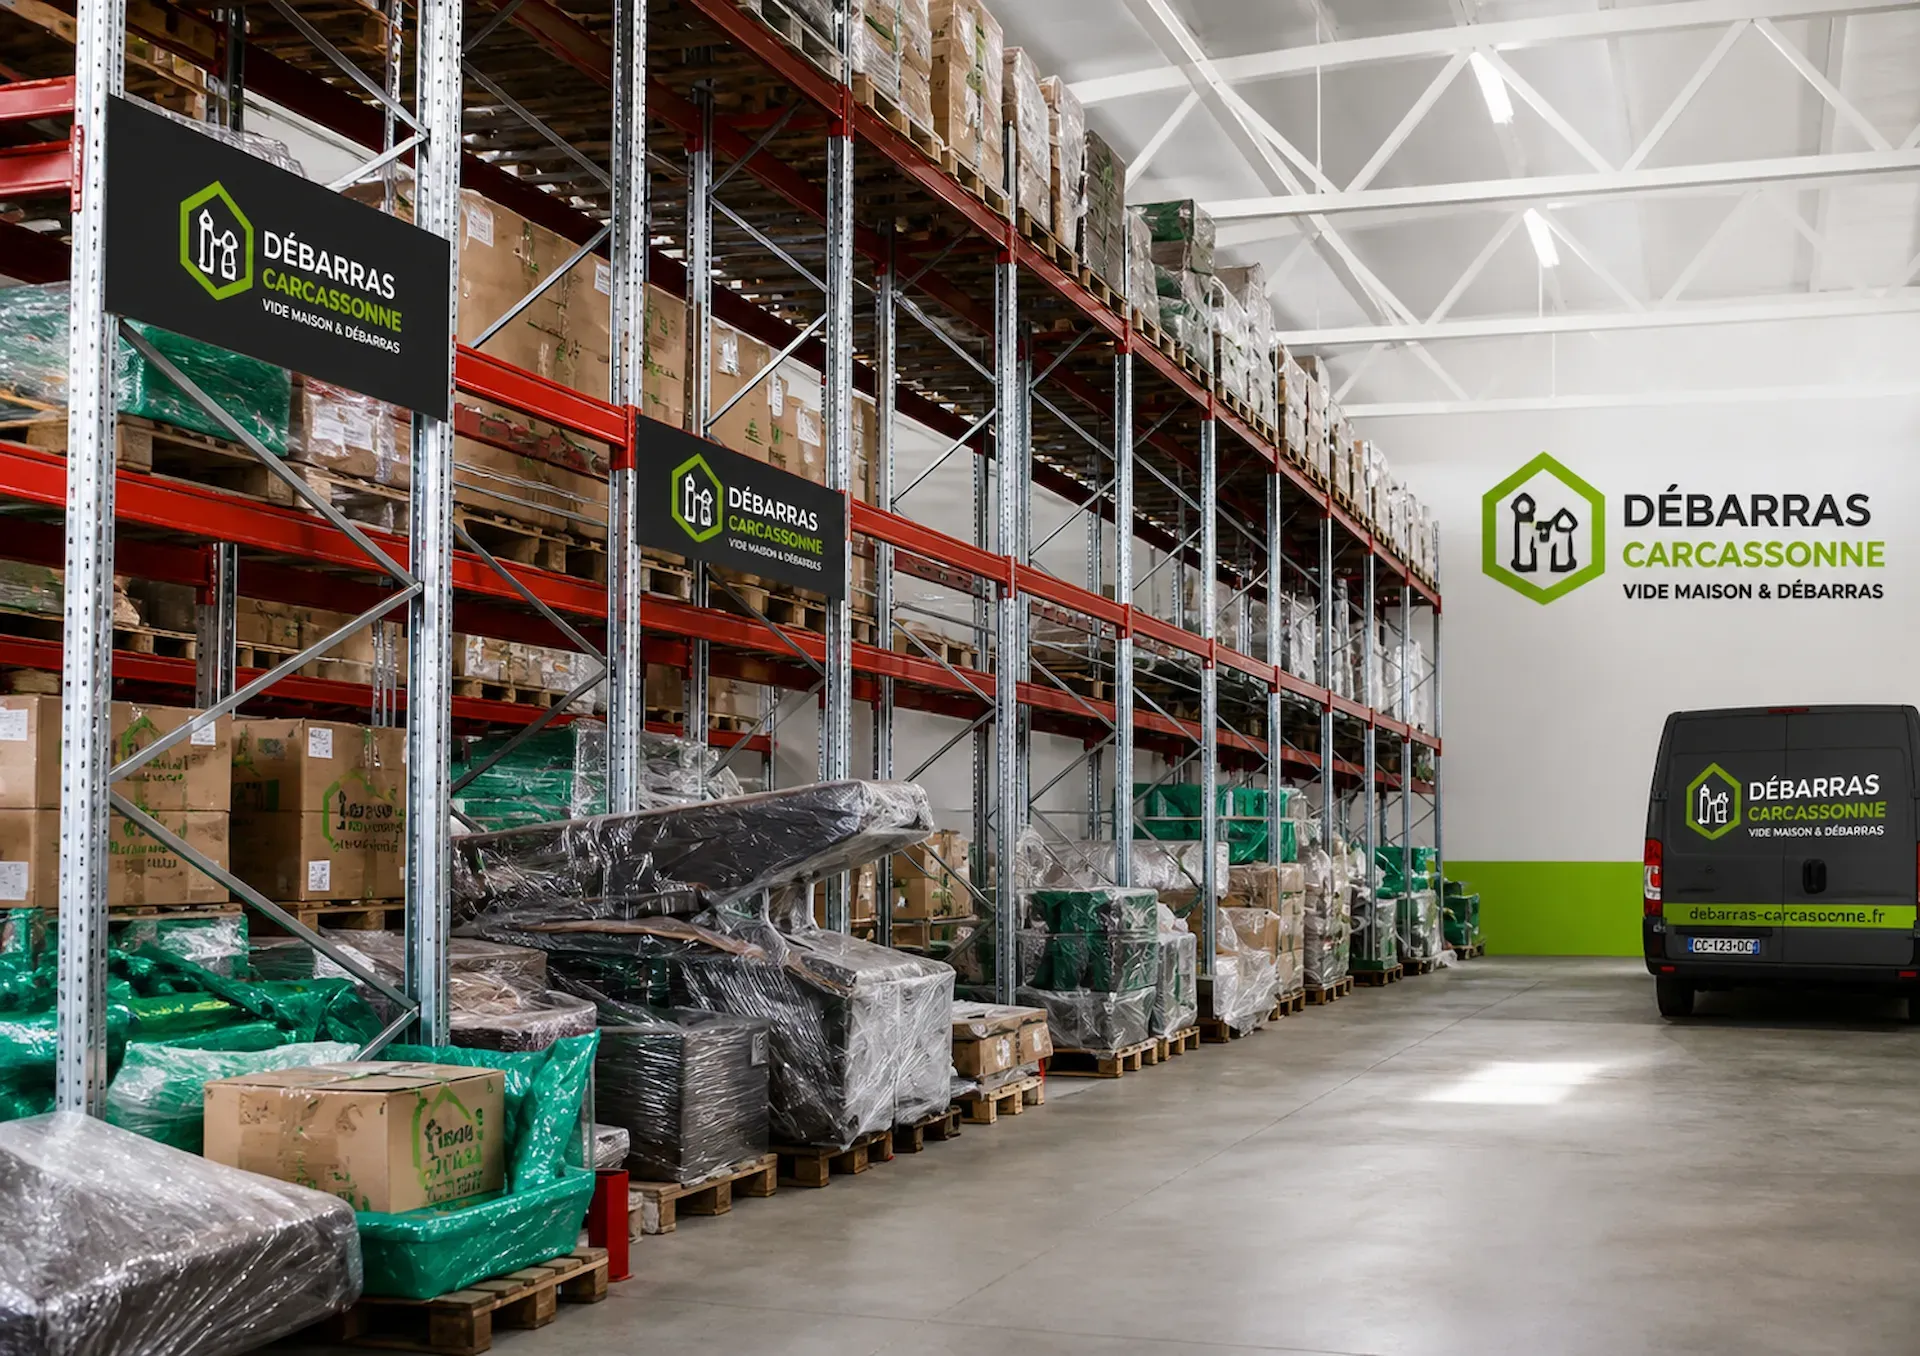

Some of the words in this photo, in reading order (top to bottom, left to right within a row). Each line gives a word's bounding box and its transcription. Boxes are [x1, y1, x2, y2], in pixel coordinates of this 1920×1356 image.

[263, 230, 396, 300] DÉBARRAS
[262, 267, 403, 333] CARCASSONNE
[262, 298, 290, 319] VIDE
[291, 308, 333, 333] MAISON
[334, 322, 343, 336] &
[345, 325, 401, 354] DÉBARRAS
[728, 485, 819, 532] DÉBARRAS
[1623, 483, 1871, 528] DÉBARRAS
[728, 514, 823, 556] CARCASSONNE
[1622, 541, 1886, 568] CARCASSONNE
[1622, 583, 1669, 600] VIDE
[1675, 583, 1752, 600] MAISON
[1758, 583, 1771, 600] &
[1777, 578, 1884, 600] DÉBARRAS
[1749, 773, 1880, 801] DÉBARRAS
[1748, 801, 1887, 822] CARCASSONNE
[1748, 827, 1771, 838] VIDE
[1773, 826, 1812, 837] MAISON
[1814, 826, 1822, 837] &
[1824, 823, 1885, 837] DÉBARRAS
